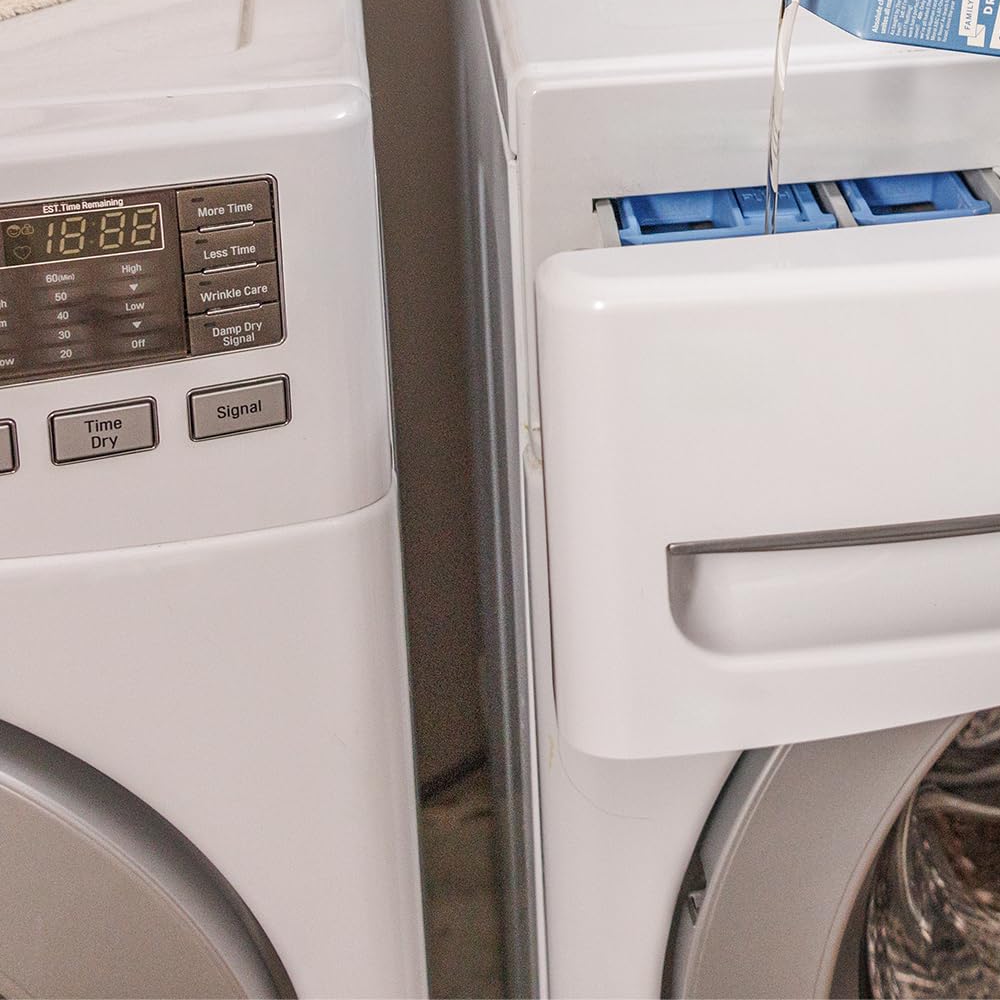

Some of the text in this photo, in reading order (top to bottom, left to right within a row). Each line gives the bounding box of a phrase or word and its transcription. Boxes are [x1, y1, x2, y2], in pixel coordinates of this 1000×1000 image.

[961, 0, 976, 30] FAMILY
[81, 198, 124, 210] Remaining
[198, 202, 253, 217] More Time
[203, 245, 256, 260] Less Time
[121, 263, 142, 275] High
[55, 292, 68, 301] 50
[200, 284, 268, 302] Wrinkle Care
[125, 302, 145, 311] Low
[57, 311, 69, 320] 40
[58, 330, 71, 339] 30
[212, 321, 262, 339] Damp Dry
[131, 339, 146, 349] Off
[223, 332, 255, 347] Signal
[60, 349, 72, 359] 20
[217, 400, 262, 419] Signal
[85, 418, 122, 433] Time
[91, 435, 118, 450] Dry
